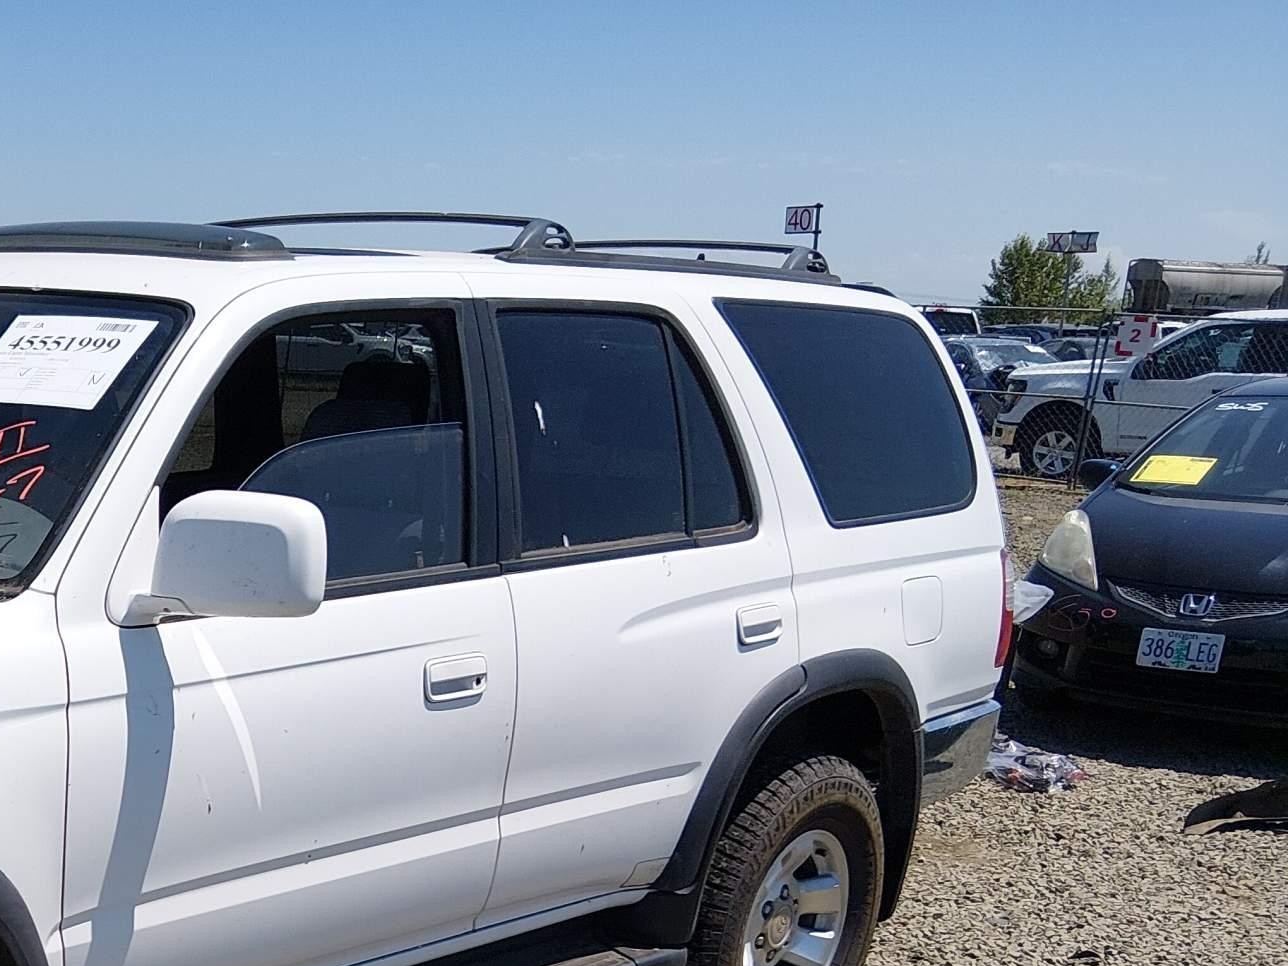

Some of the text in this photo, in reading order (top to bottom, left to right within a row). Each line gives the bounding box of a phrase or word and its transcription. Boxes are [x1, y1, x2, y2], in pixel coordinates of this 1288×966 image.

[787, 208, 812, 231] 40
[1050, 233, 1064, 250] K
[1079, 233, 1092, 251] J
[7, 334, 122, 354] 45551999
[1129, 328, 1142, 343] 2
[1141, 637, 1219, 664] 386 LEG
